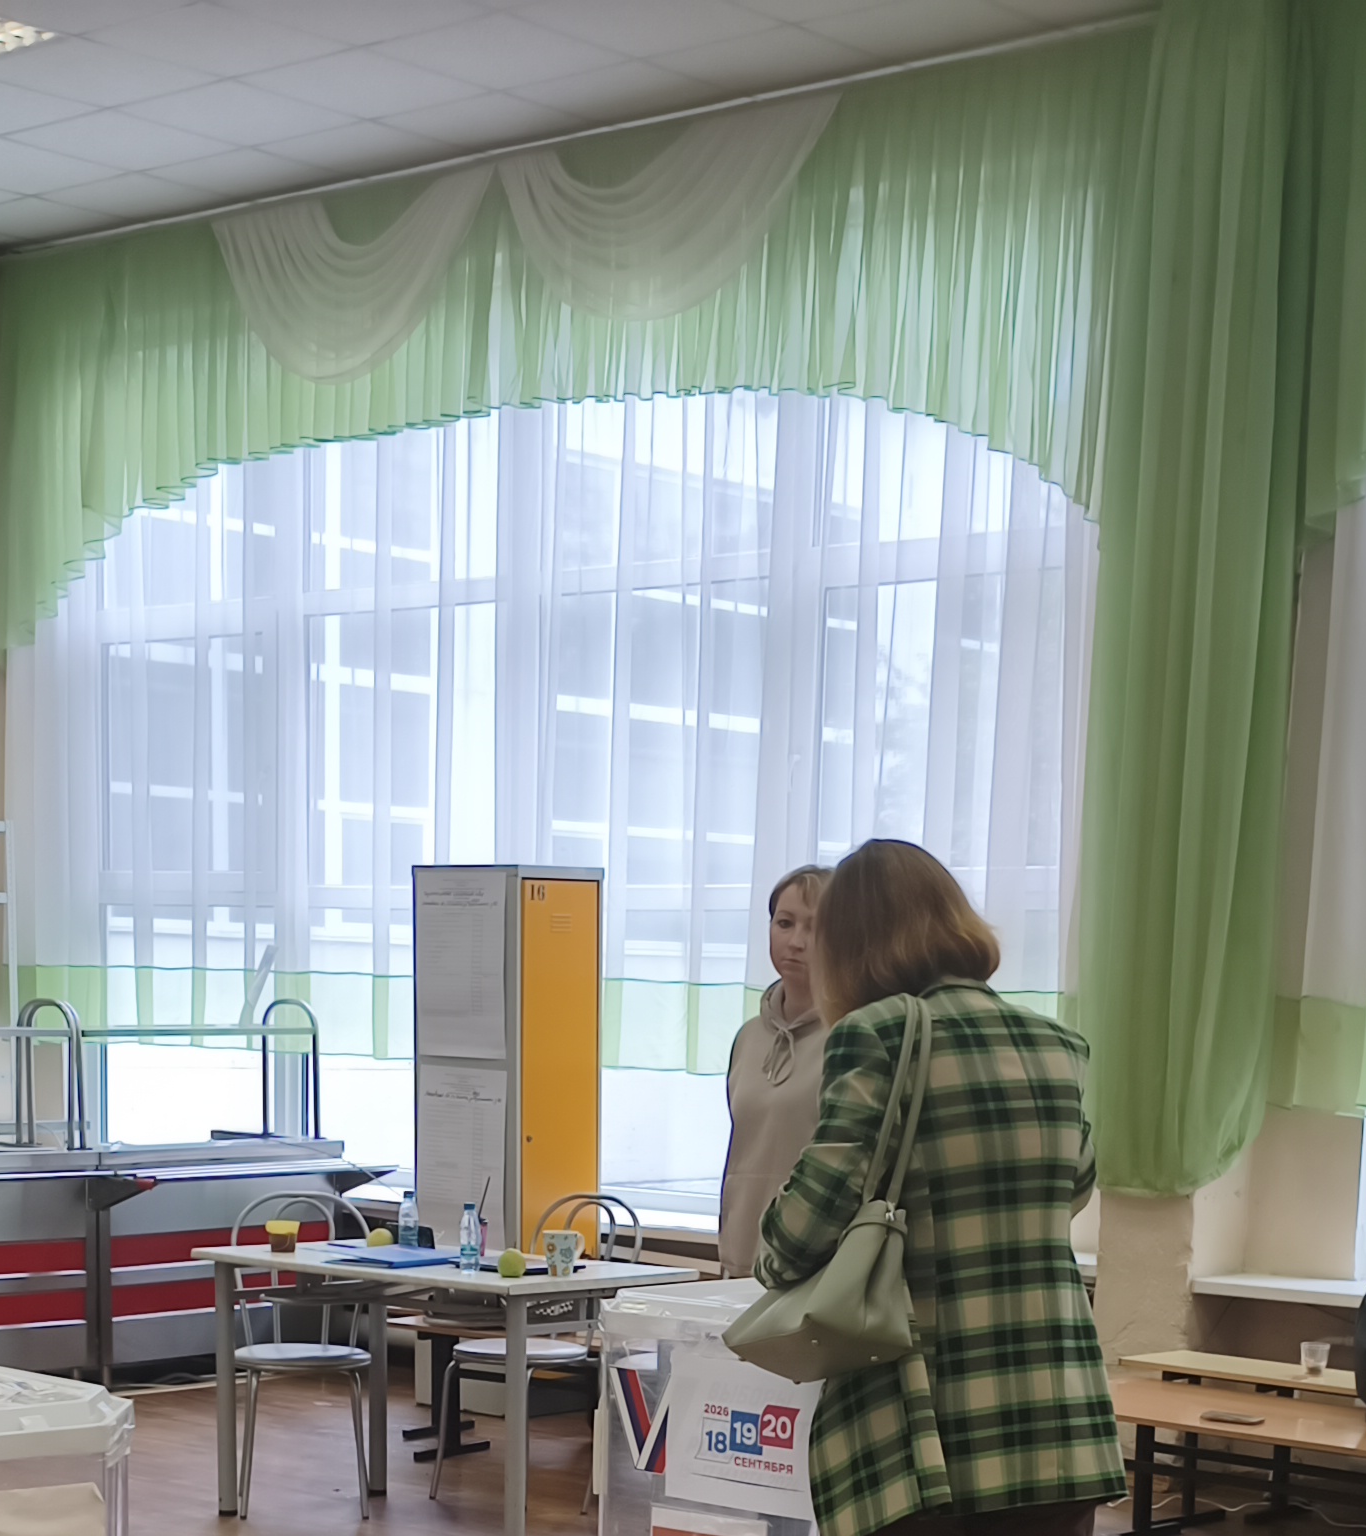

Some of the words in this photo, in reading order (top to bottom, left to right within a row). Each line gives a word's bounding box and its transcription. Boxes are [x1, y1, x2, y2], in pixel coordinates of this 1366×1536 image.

[704, 1403, 730, 1417] 2026
[705, 1430, 728, 1454] 18
[733, 1421, 757, 1446] 19
[762, 1413, 793, 1440] 20
[734, 1456, 794, 1475] СЕНТЯБРЯ
